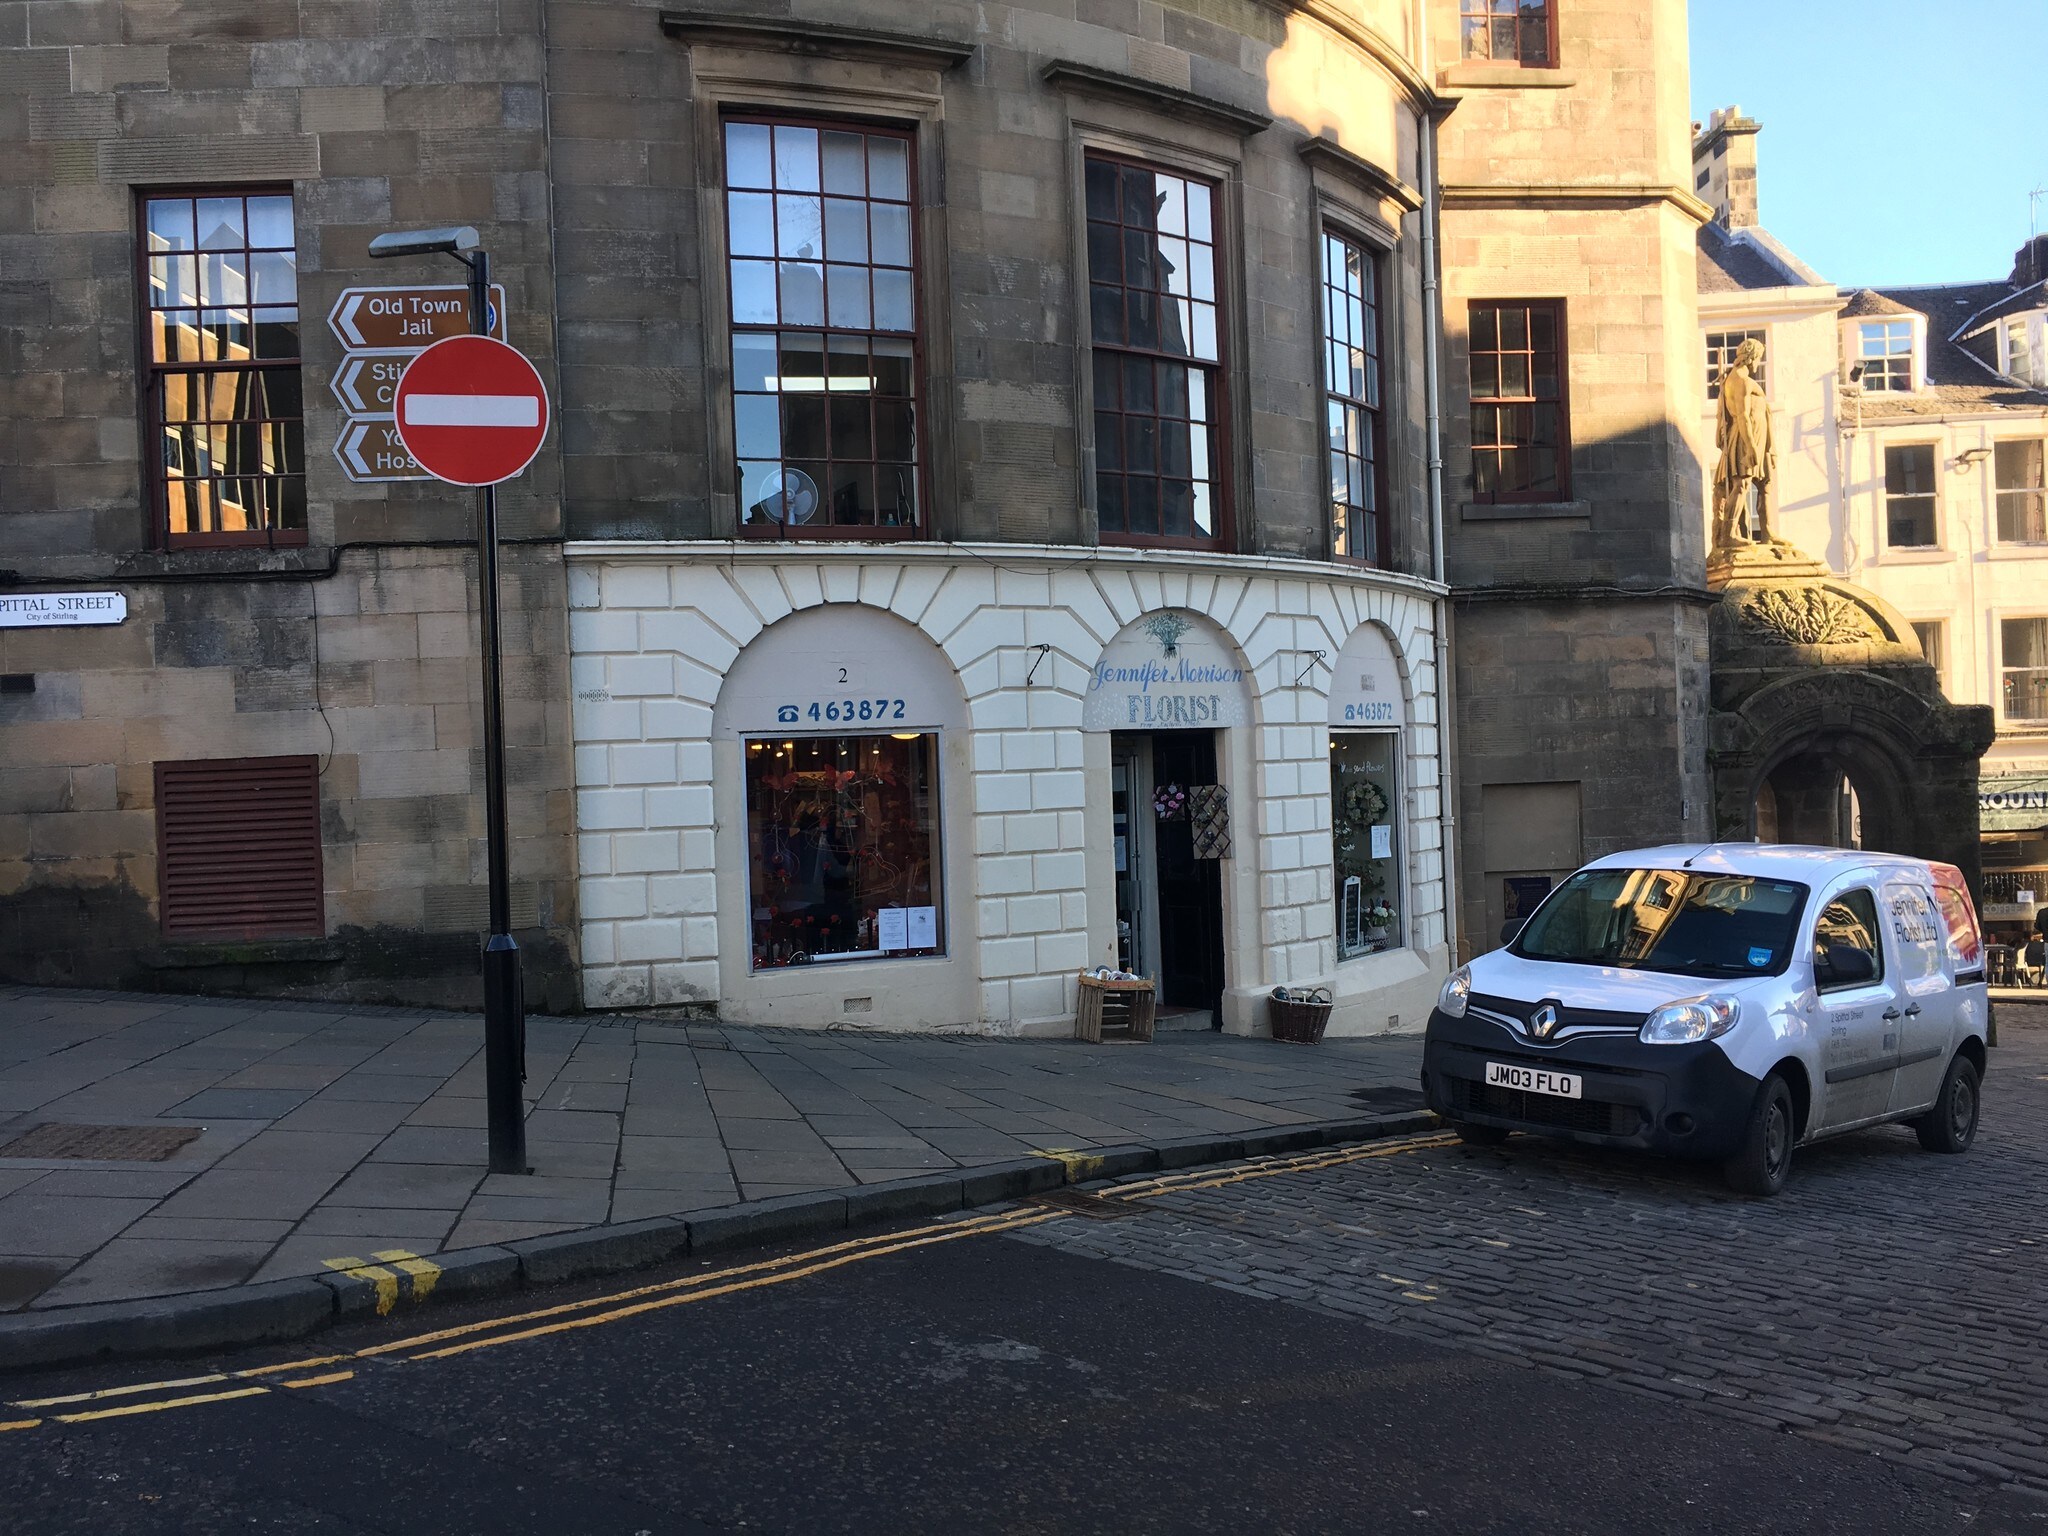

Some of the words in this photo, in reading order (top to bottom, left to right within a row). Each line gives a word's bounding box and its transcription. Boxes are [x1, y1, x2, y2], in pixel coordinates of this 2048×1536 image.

[369, 299, 403, 315] Old
[409, 297, 462, 314] Town
[399, 319, 434, 336] Jail
[372, 363, 406, 381] Sti
[381, 429, 403, 447] Yo
[376, 452, 417, 469] Hos
[57, 596, 114, 610] STREET
[26, 613, 41, 622] City
[52, 612, 78, 620] Stirling
[837, 668, 848, 683] 2
[1088, 658, 1169, 692] Jennifer
[1171, 658, 1242, 683] Morrison
[807, 699, 906, 722] 463872
[1127, 694, 1221, 723] FLORIST
[1356, 702, 1392, 720] 463872
[1891, 896, 1926, 916] Jennifer
[1983, 904, 2022, 914] COFFEE
[1895, 922, 1921, 943] Florist
[1922, 921, 1938, 941] Ltd
[1831, 1013, 1834, 1023] 2
[1850, 1010, 1864, 1020] Street
[1490, 1065, 1532, 1088] JM03
[1536, 1073, 1571, 1094] FLO
